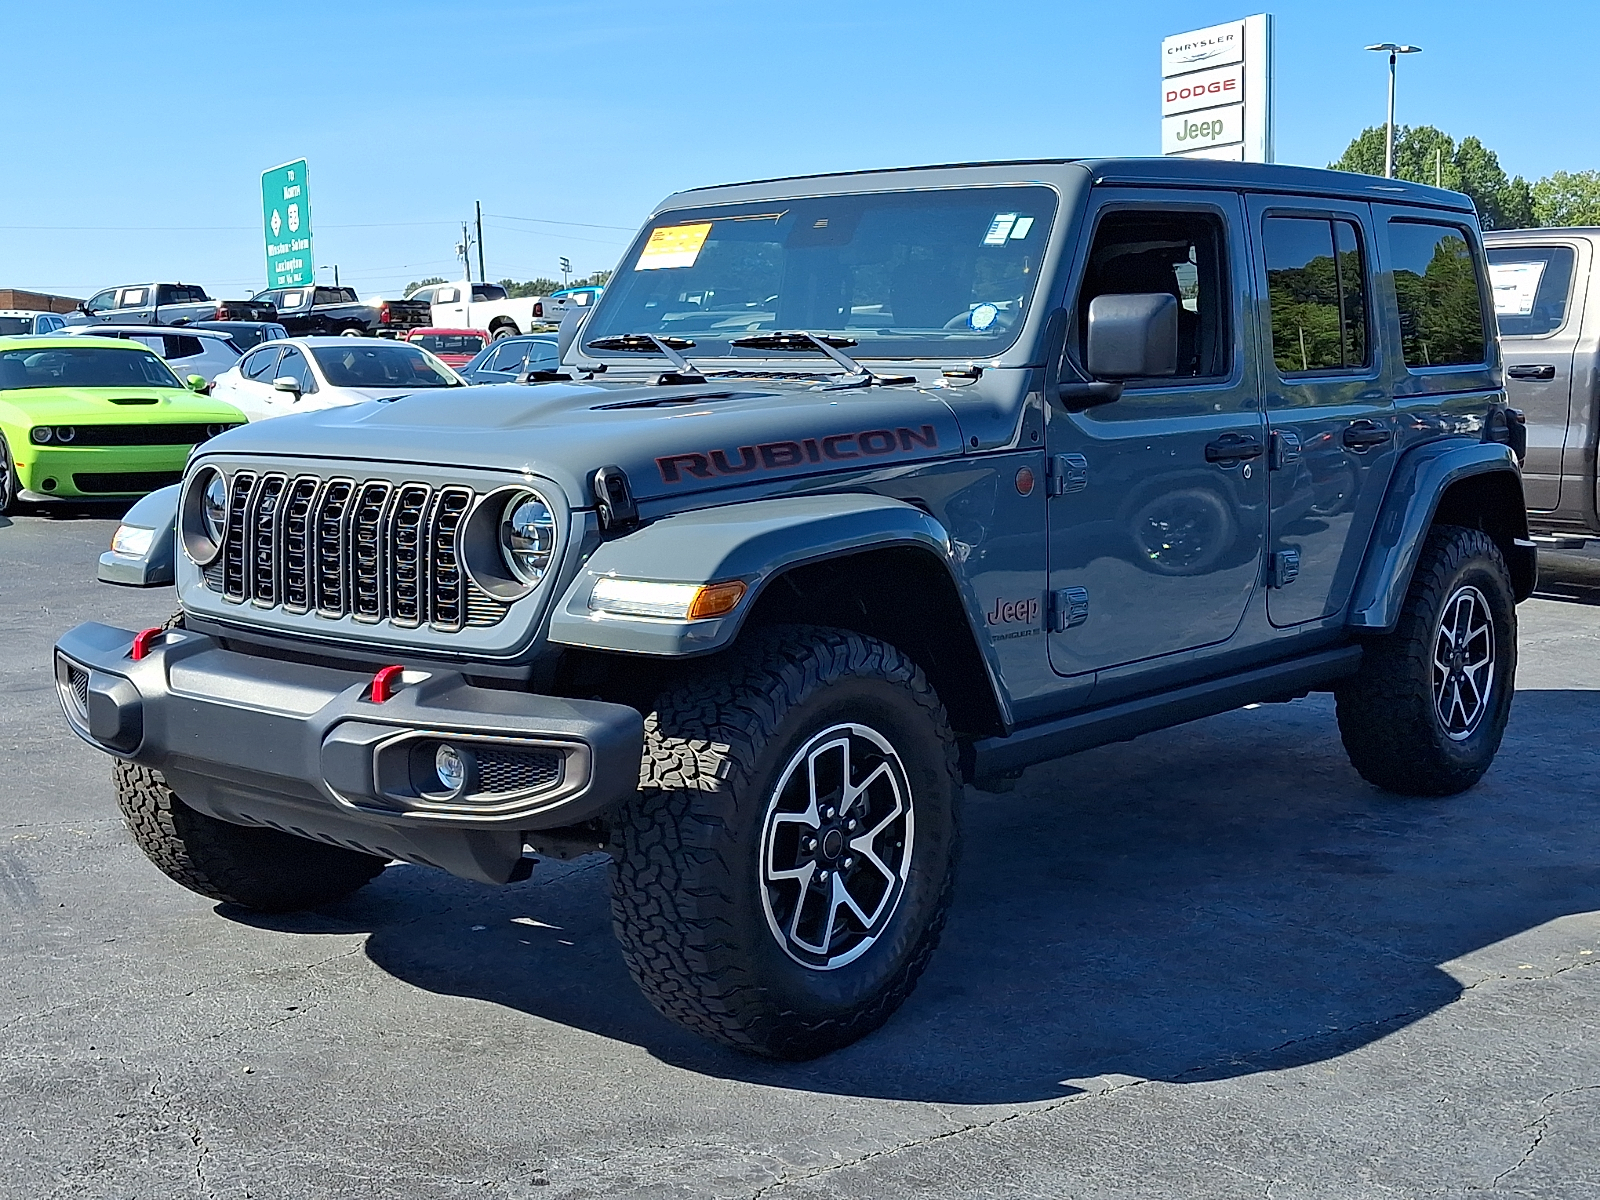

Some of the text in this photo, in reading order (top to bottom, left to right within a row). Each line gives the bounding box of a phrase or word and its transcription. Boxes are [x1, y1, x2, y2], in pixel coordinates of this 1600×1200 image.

[1167, 34, 1234, 55] CHRYSLER
[1166, 78, 1237, 103] DODGE
[1176, 119, 1224, 141] Jeep
[267, 238, 309, 257] Winston-Salem
[275, 257, 303, 273] Lexington
[655, 424, 939, 484] RUBICON
[987, 597, 1038, 626] Jeep
